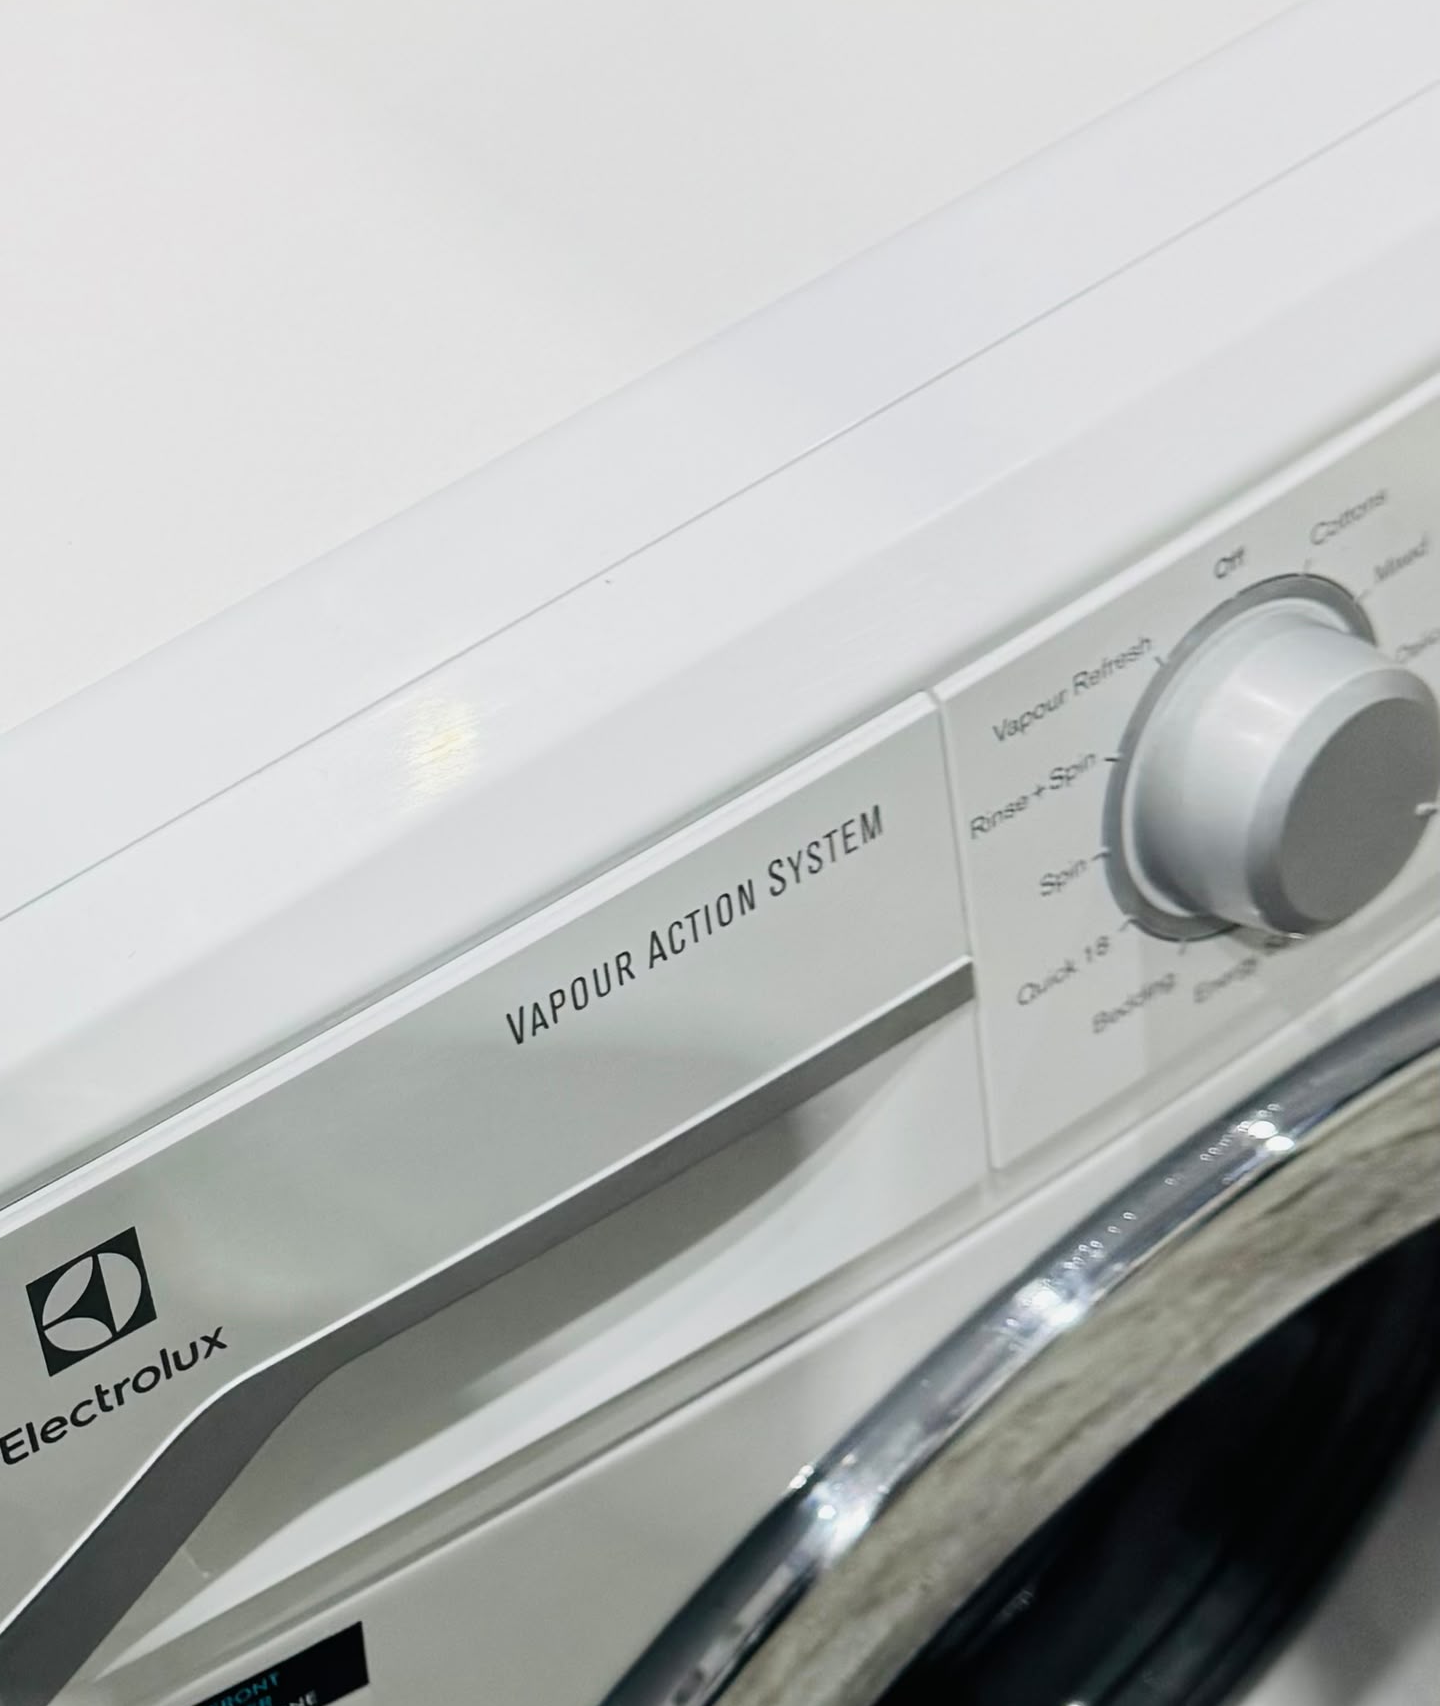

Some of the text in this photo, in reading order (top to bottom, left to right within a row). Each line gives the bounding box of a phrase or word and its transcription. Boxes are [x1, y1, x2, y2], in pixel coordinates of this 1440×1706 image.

[1214, 546, 1246, 579] Off
[992, 636, 1152, 742] Vapour Refresh
[1040, 859, 1088, 897] Spin
[506, 805, 884, 1045] VAPOUR ACTION SYSTEM
